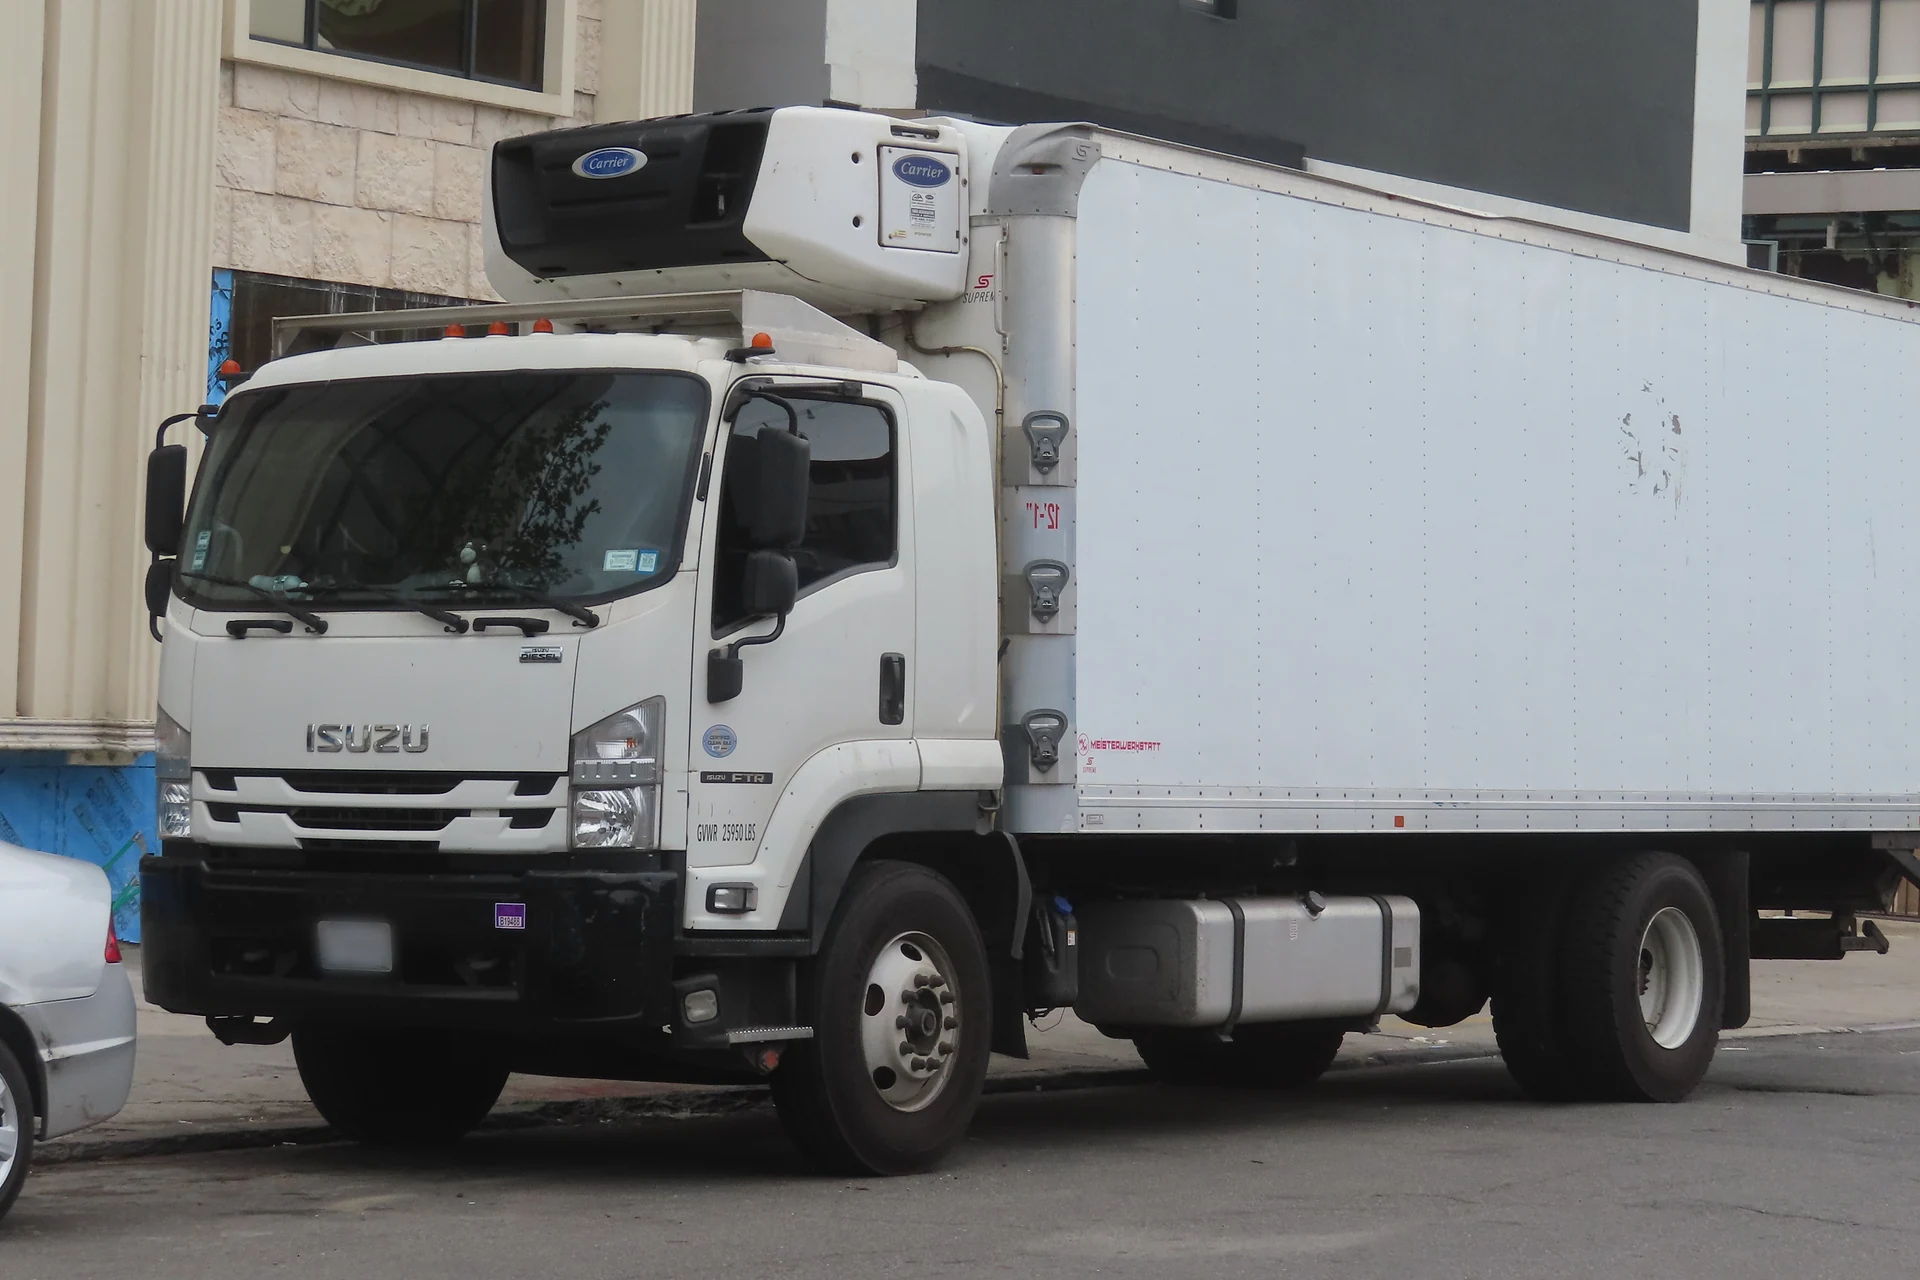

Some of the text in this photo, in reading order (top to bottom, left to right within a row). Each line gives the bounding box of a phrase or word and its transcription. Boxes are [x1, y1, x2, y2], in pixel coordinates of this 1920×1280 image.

[589, 156, 629, 170] Carrier
[901, 161, 944, 178] Carrier
[962, 291, 996, 304] SUPREM
[521, 653, 559, 661] DIESEL
[306, 723, 430, 753] ISUZU
[1090, 740, 1161, 751] MEISTERWERKSTATT
[732, 773, 765, 783] FTR
[697, 823, 756, 842] GVWR 25950 LBS
